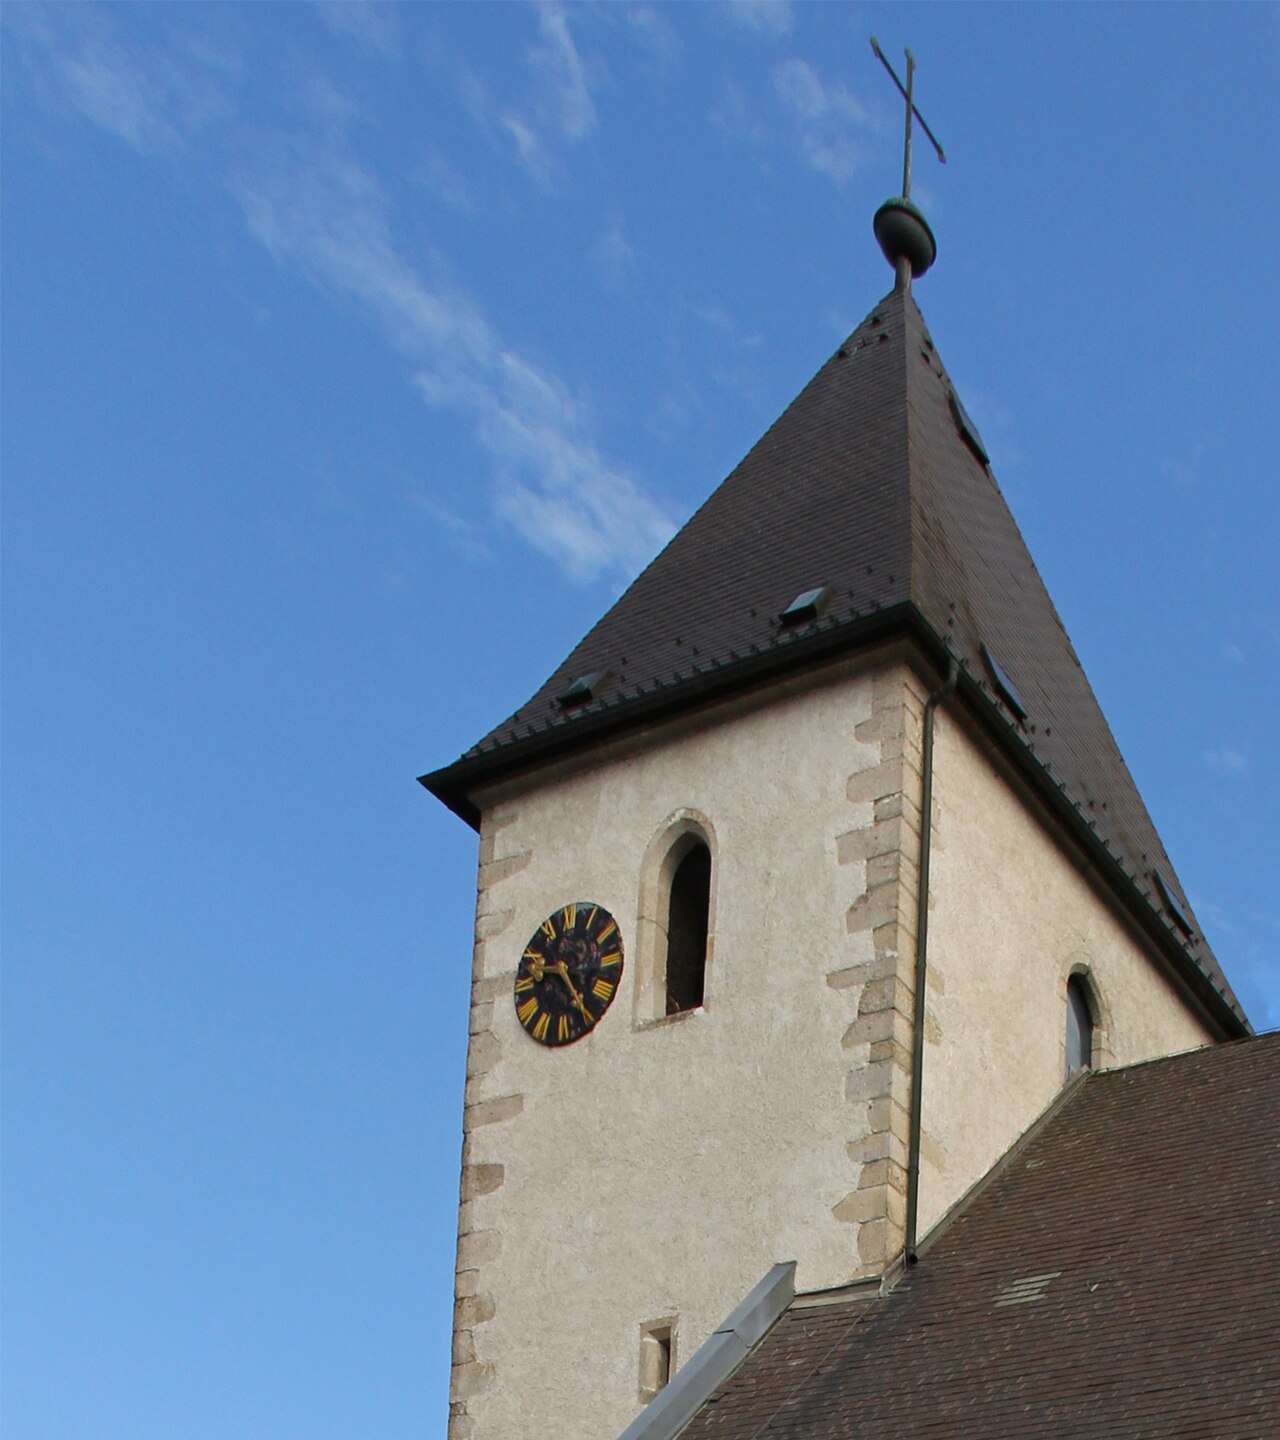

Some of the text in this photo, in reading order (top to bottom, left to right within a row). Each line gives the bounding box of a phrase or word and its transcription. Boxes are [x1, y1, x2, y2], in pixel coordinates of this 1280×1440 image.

[563, 903, 577, 932] XII
[597, 920, 617, 944] II
[601, 951, 620, 968] III
